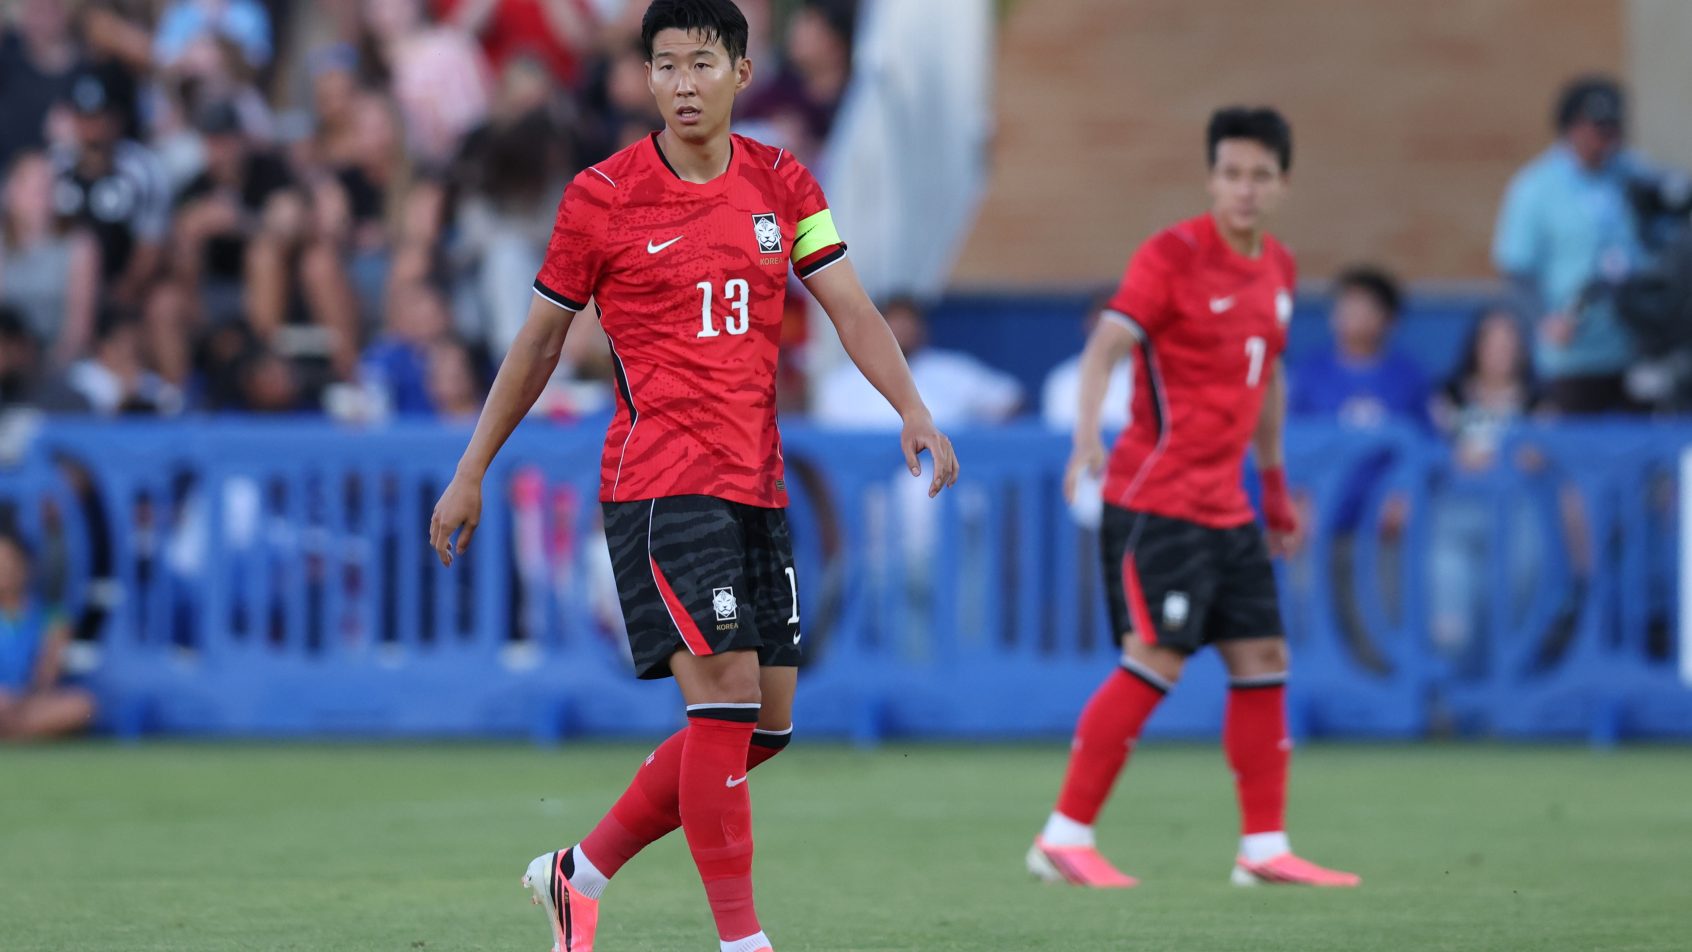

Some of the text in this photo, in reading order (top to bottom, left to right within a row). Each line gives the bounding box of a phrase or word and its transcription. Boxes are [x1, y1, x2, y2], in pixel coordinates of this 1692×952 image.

[696, 278, 750, 339] 13
[1245, 336, 1267, 388] 7
[716, 622, 739, 631] KOREA
